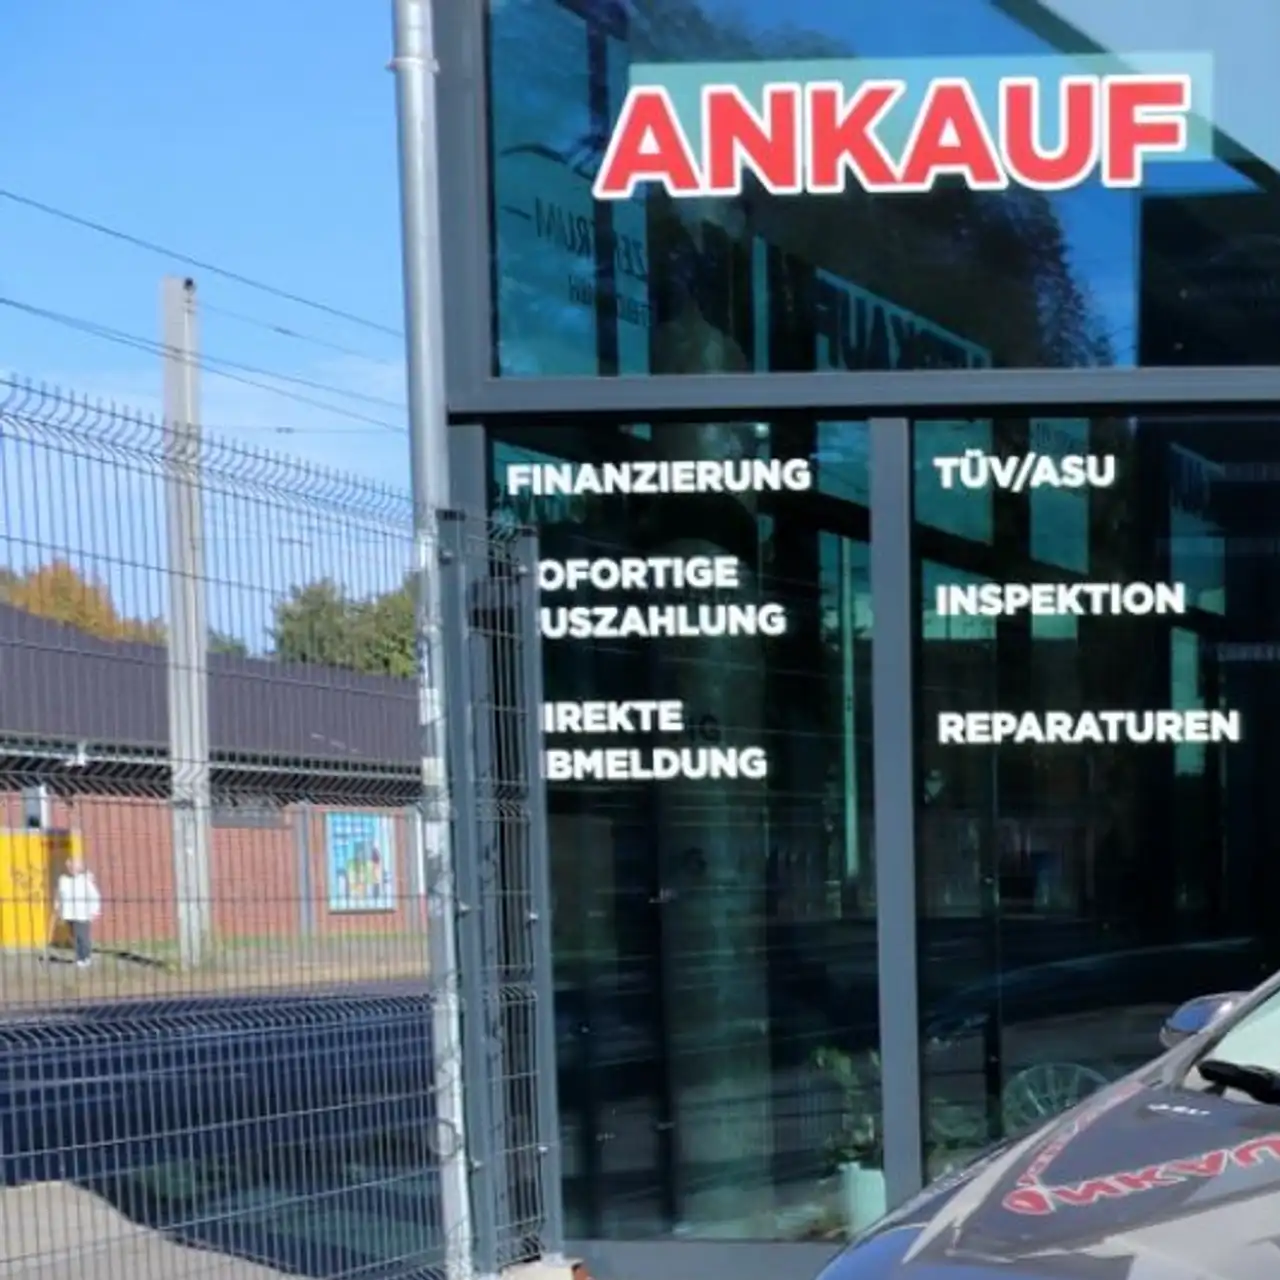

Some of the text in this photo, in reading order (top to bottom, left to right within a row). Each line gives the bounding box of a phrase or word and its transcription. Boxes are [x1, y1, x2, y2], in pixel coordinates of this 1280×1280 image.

[592, 75, 1192, 199] ANKAUF
[506, 458, 812, 495] FINANZIERUNG
[933, 449, 1115, 492] TÜV/ASU
[537, 556, 739, 590] OFORTIGE
[936, 582, 1186, 616] INSPEKTION
[538, 604, 787, 638] USZAHLUNG
[543, 701, 684, 732] IREKTE
[938, 710, 1240, 743] REPARATUREN
[543, 748, 768, 780] BMELDUNG
